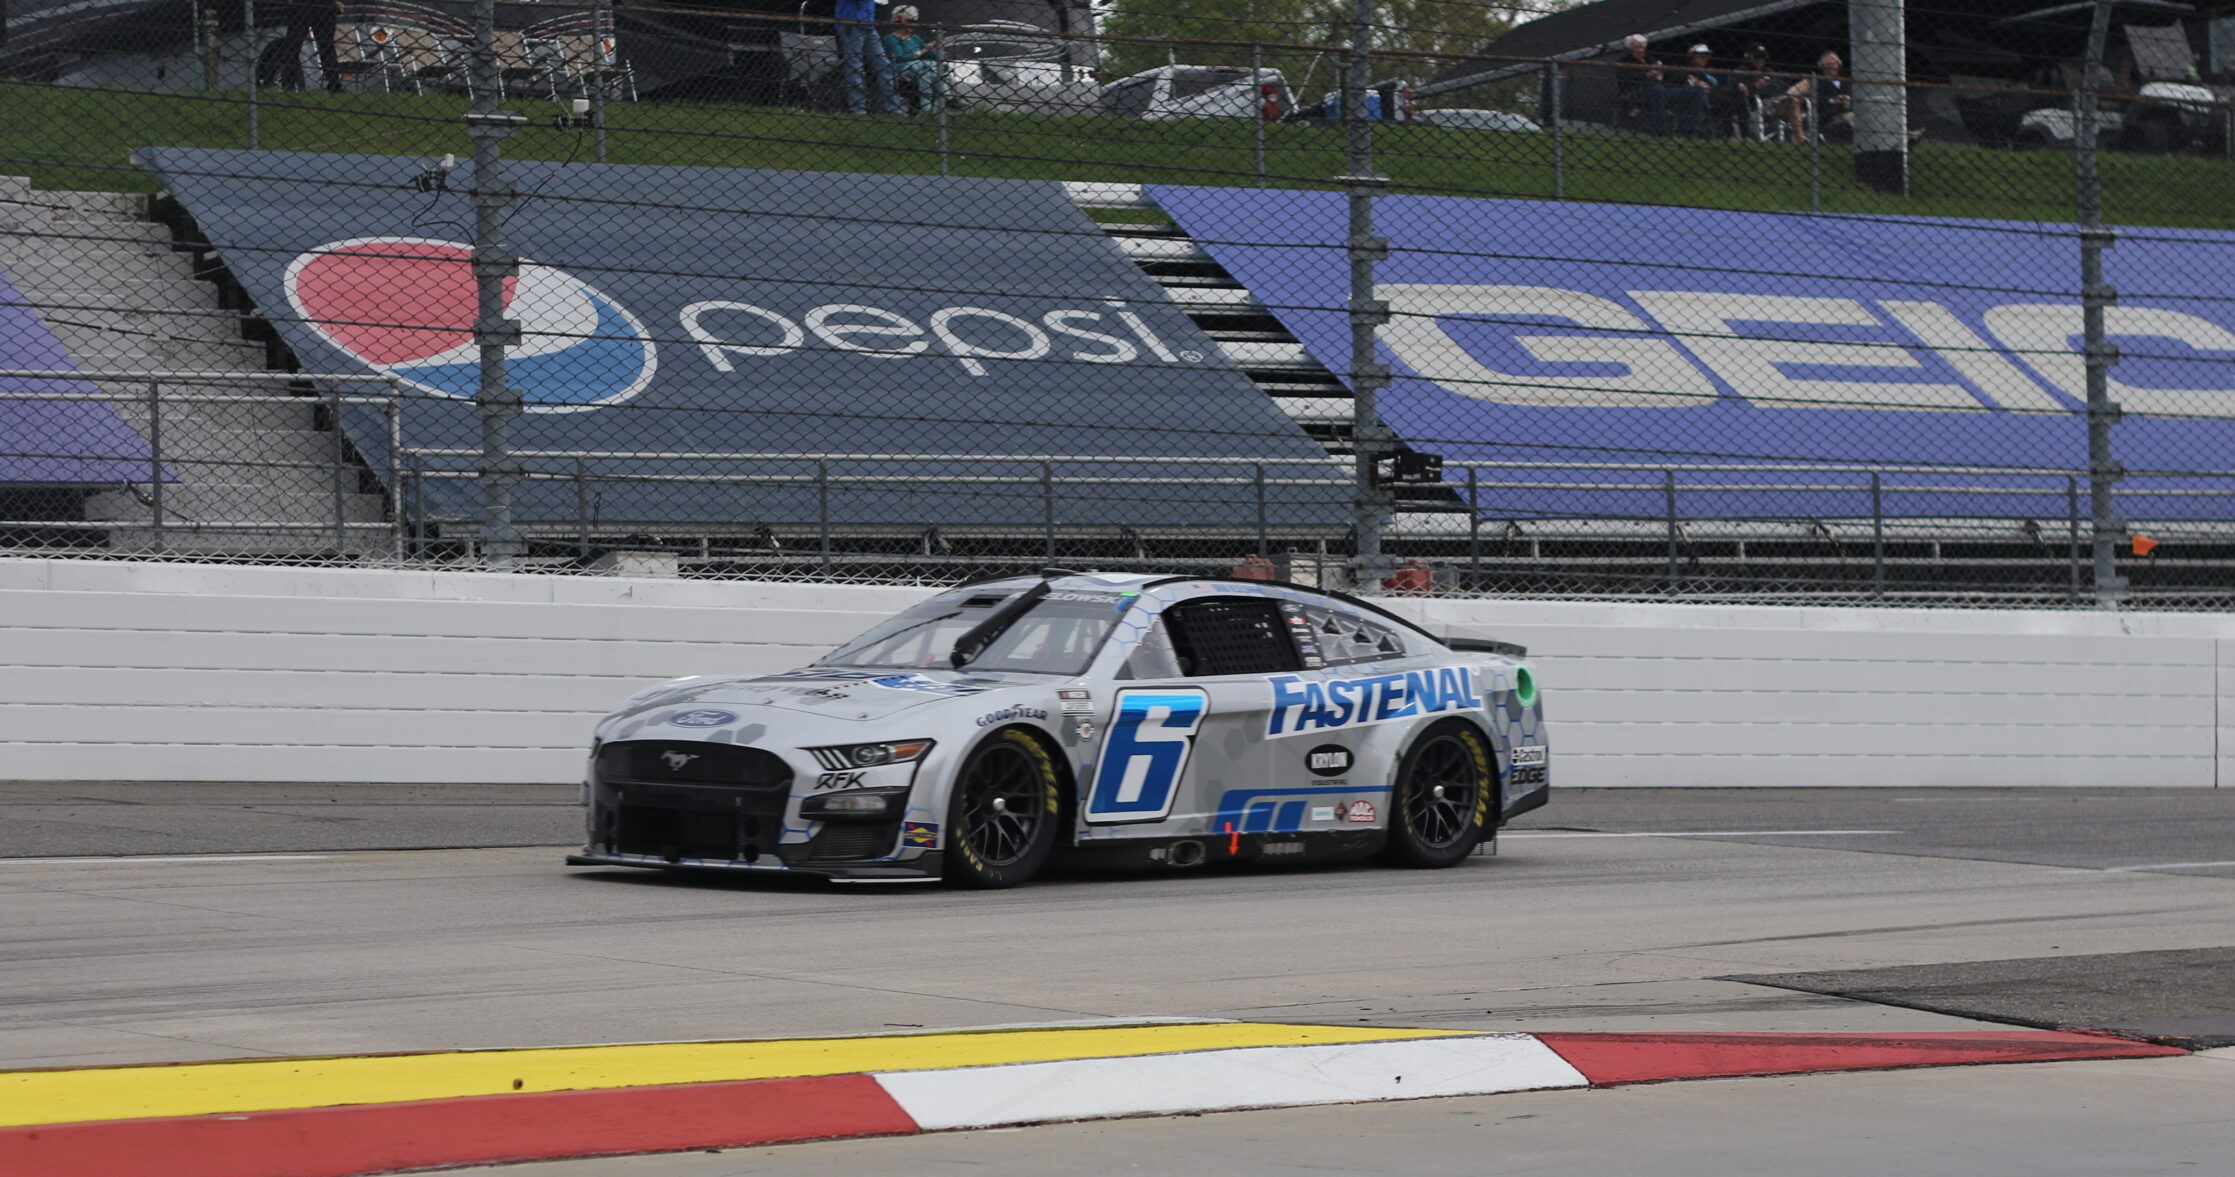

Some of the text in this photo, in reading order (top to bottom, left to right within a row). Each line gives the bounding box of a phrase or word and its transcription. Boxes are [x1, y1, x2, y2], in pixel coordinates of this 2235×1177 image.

[679, 296, 1179, 377] pepsi
[976, 703, 1049, 727] GOODYEAR
[1266, 666, 1483, 738] FASTENAL
[1087, 689, 1207, 820] 6
[1511, 767, 1546, 786] EDGE
[814, 771, 868, 790] RFK
